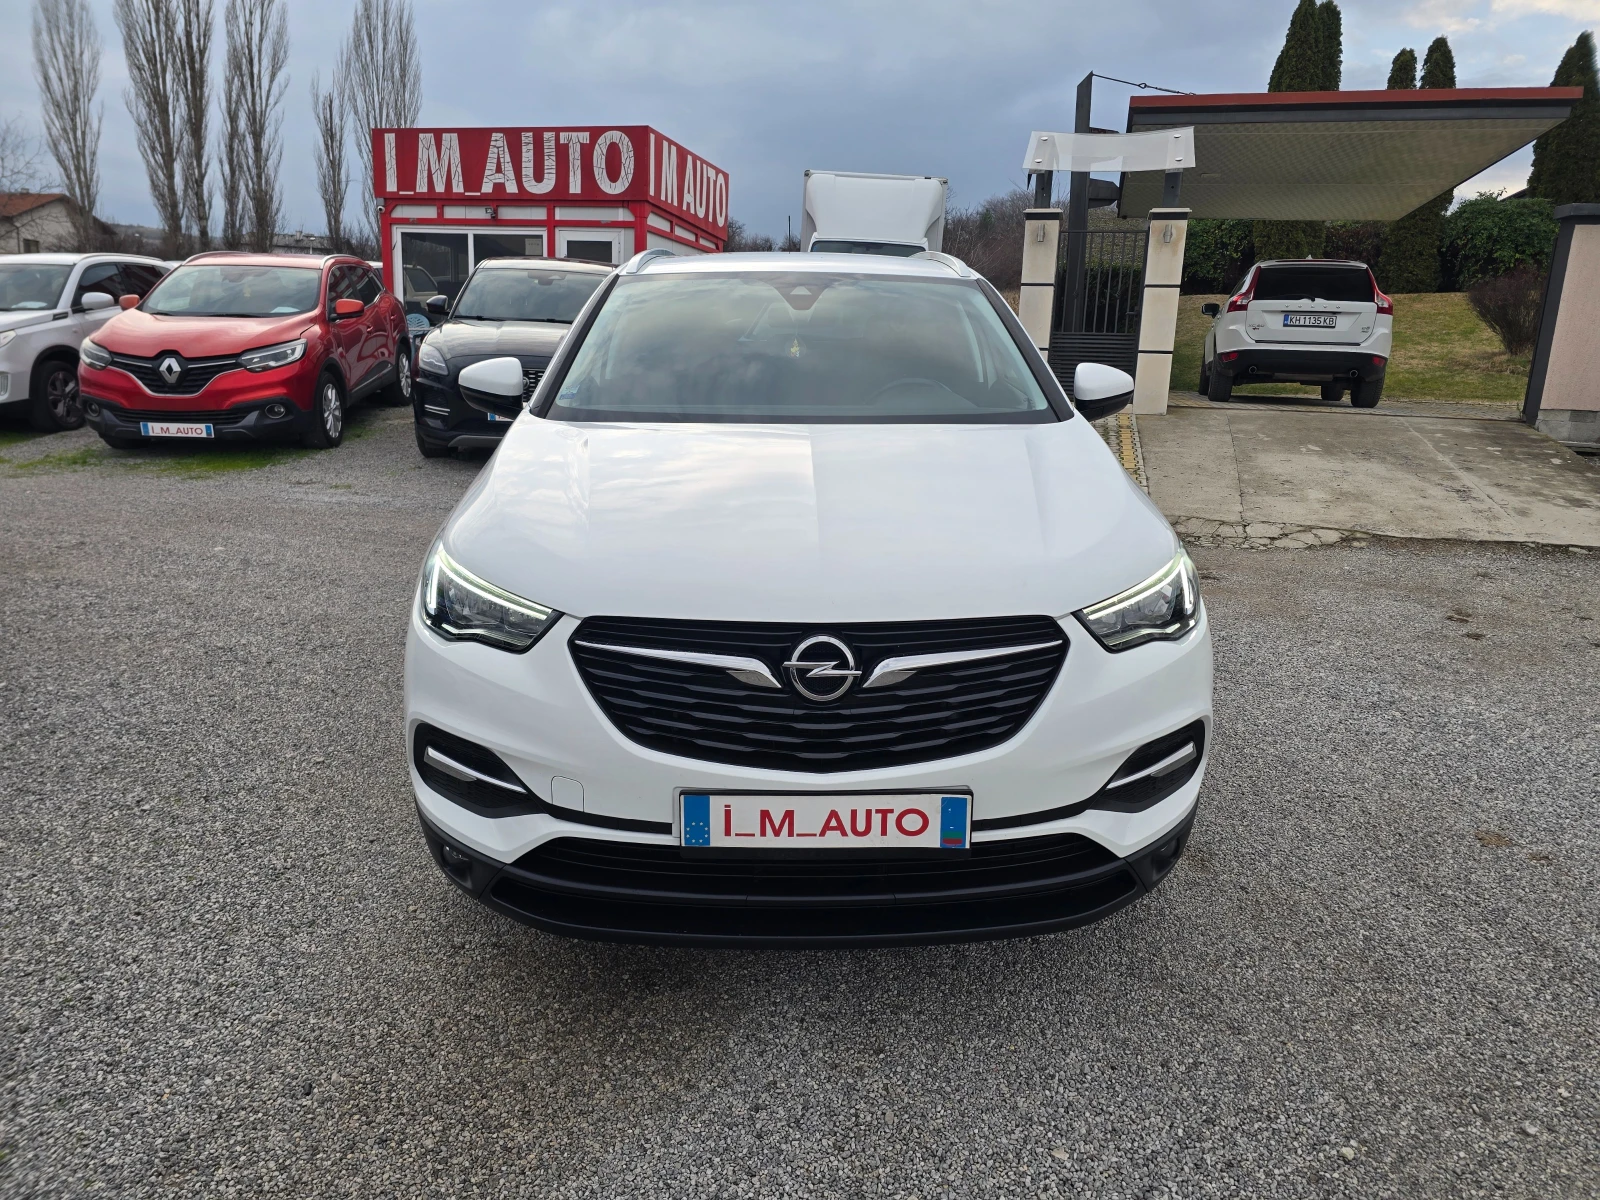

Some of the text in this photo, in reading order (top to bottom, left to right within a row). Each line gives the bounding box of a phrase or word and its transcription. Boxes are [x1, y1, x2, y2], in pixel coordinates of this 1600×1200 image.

[649, 132, 726, 228] I M AUTO
[1303, 316, 1322, 325] 1135
[151, 425, 203, 436] I_M_AUTO
